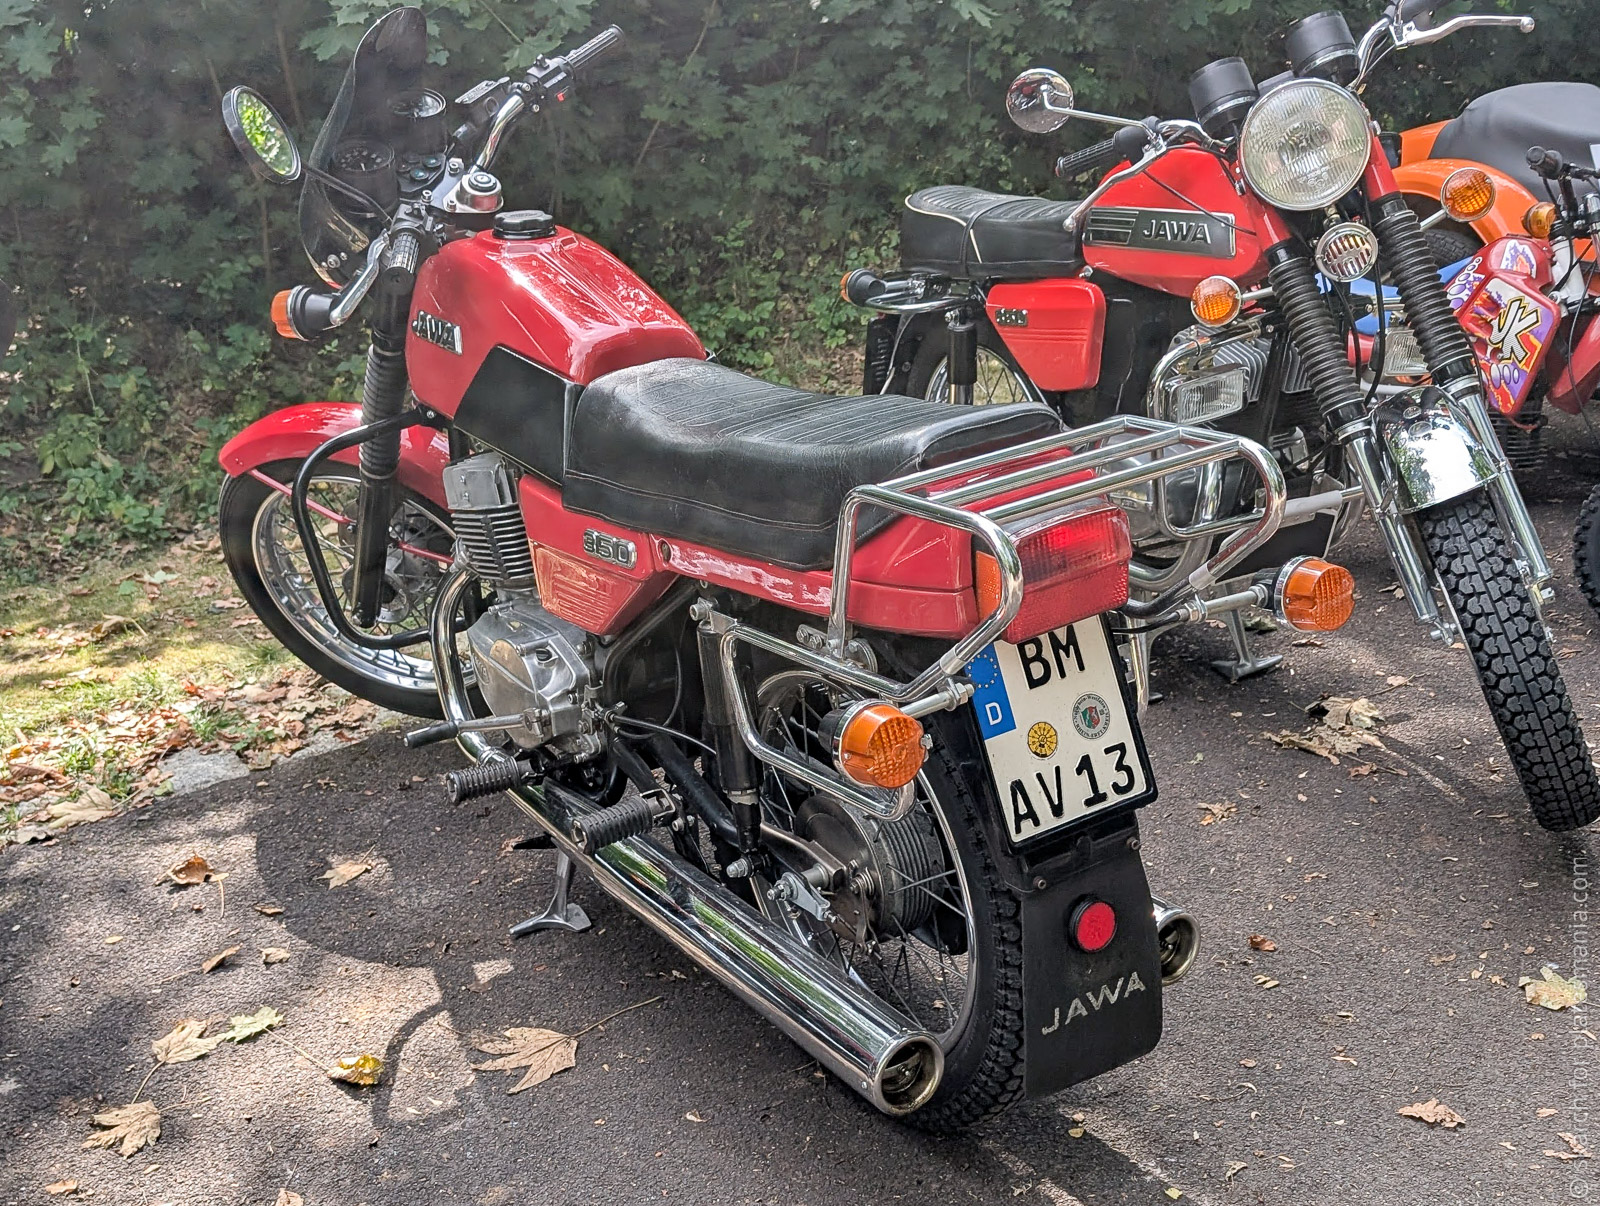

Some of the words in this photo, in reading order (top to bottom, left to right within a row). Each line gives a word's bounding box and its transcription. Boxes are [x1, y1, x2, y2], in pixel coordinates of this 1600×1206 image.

[1143, 219, 1211, 244] JAWA
[412, 310, 463, 356] JAWA
[583, 528, 637, 570] 350
[1017, 624, 1085, 690] BM
[985, 702, 1003, 726] D
[1009, 765, 1064, 834] AV
[1075, 742, 1135, 808] 13
[1041, 971, 1146, 1035] JAWA
